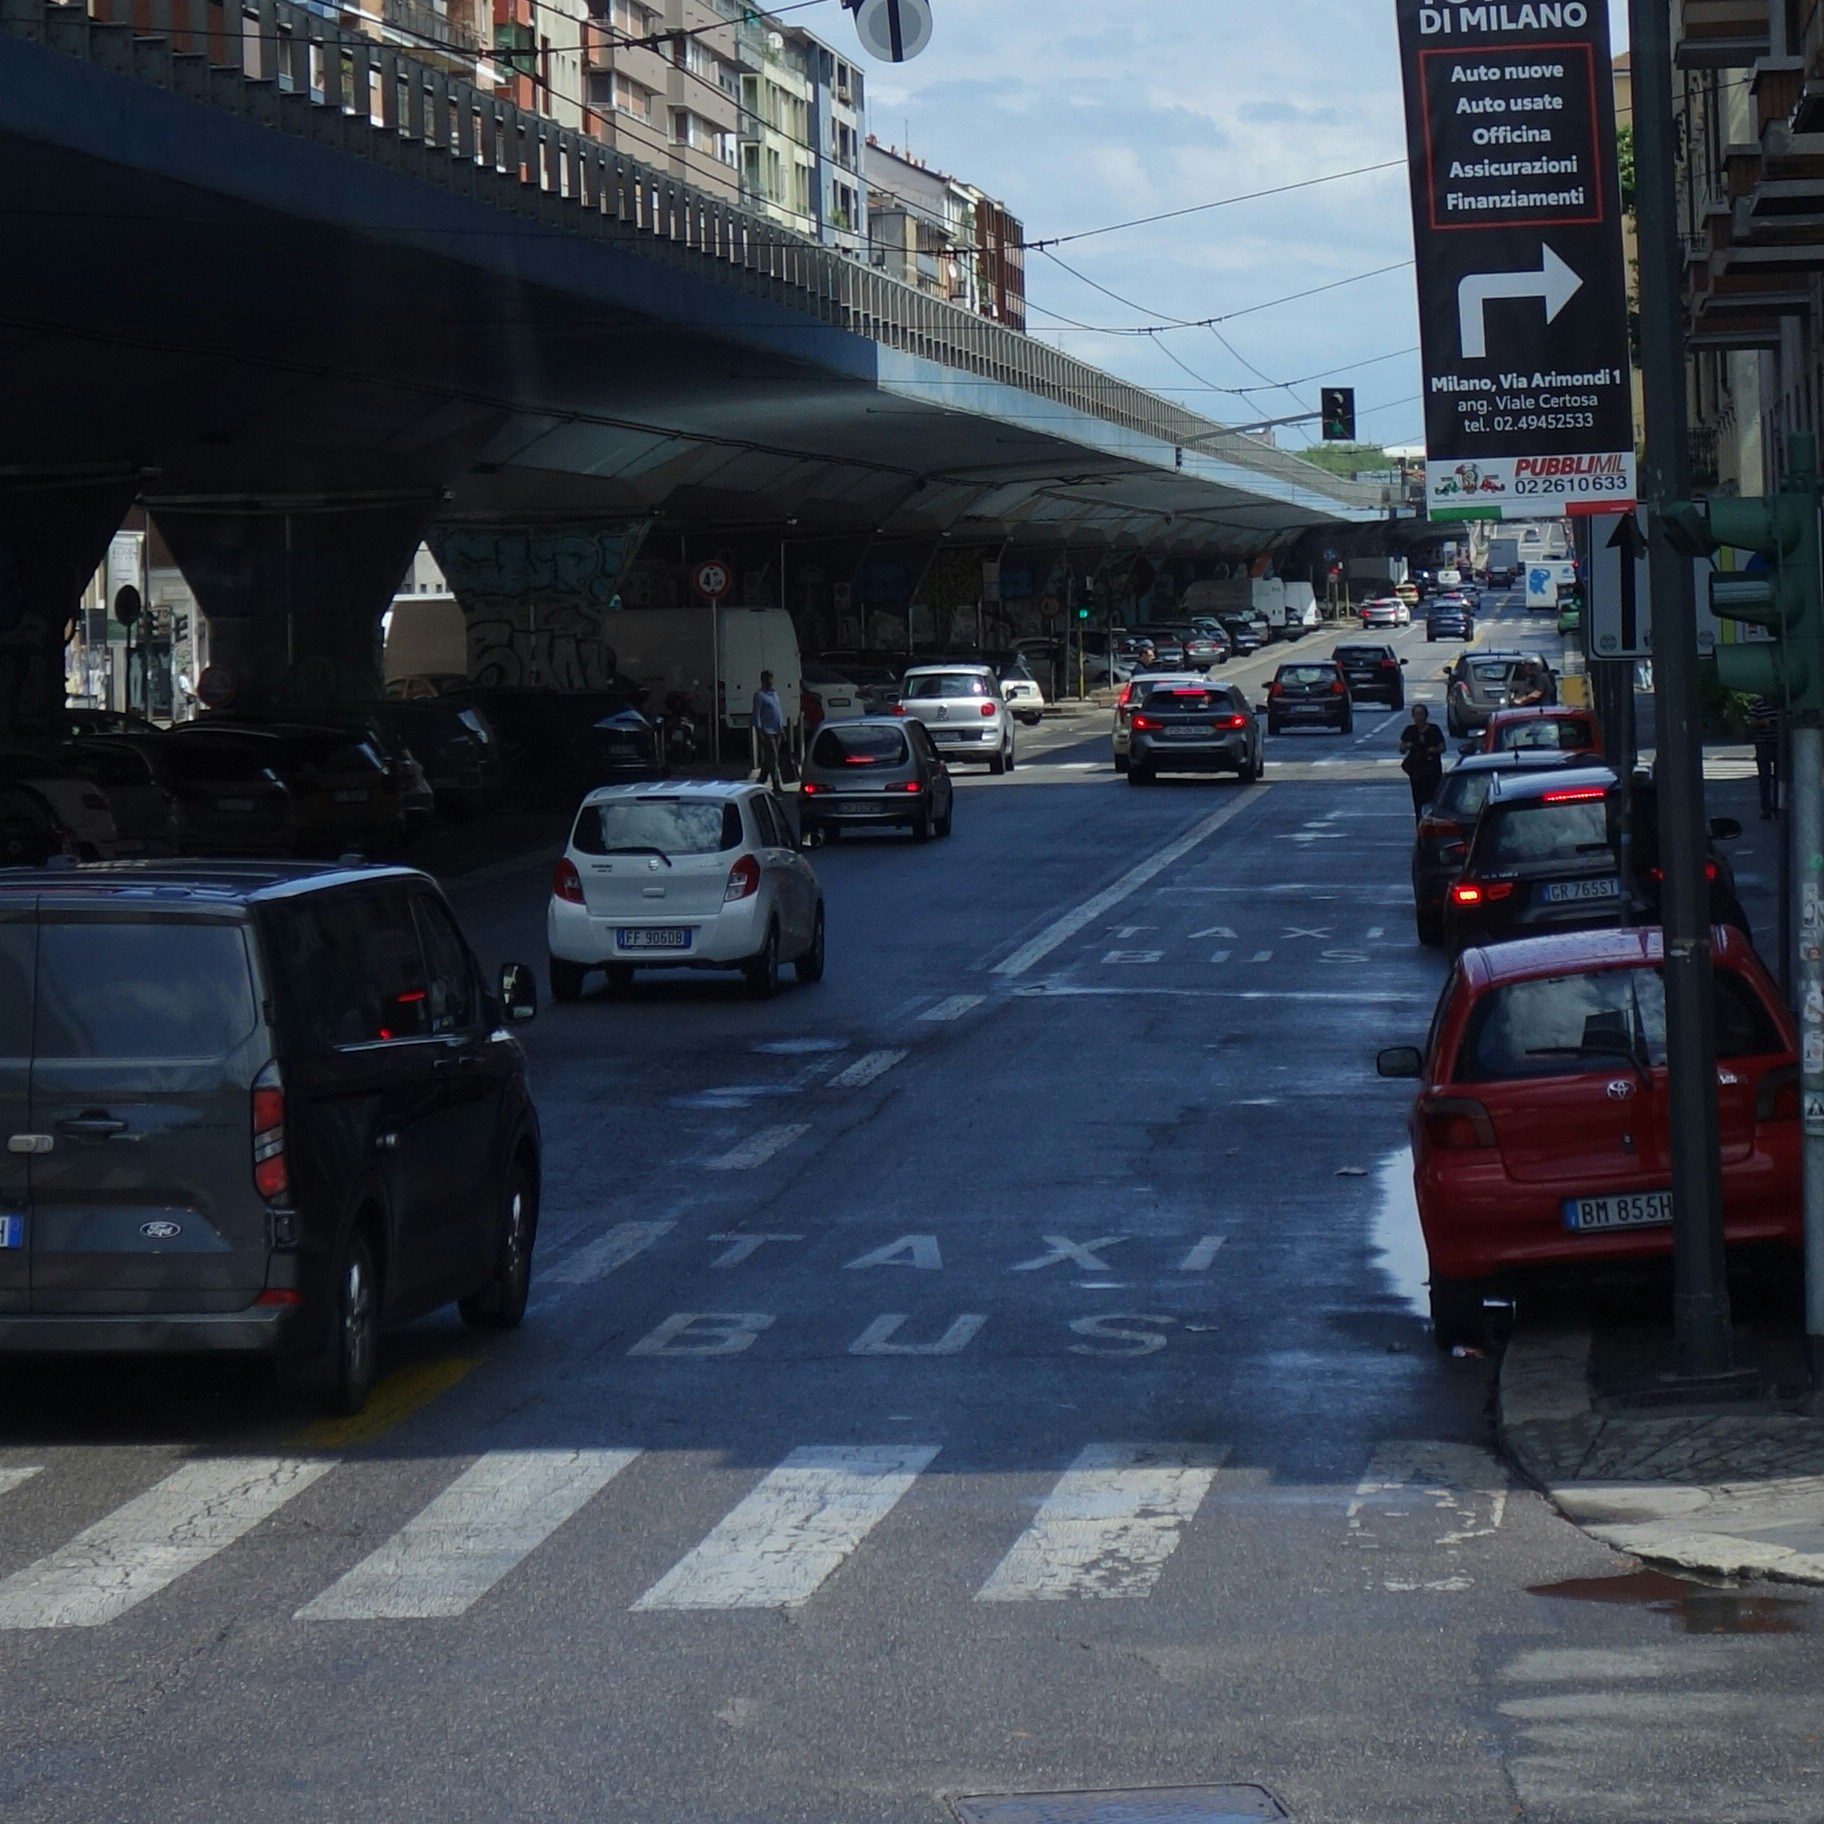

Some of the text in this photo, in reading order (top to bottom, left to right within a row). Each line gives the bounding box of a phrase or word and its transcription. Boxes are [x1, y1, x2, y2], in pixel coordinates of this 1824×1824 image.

[1419, 2, 1587, 34] DI MILANO
[1451, 64, 1564, 83] Auto nuove
[1456, 94, 1563, 114] Auto usate
[1472, 125, 1551, 145] Officina
[1449, 155, 1578, 178] Assicurazioni
[1446, 187, 1584, 210] Finanziamenti
[1431, 368, 1621, 393] Milano, Via Arimondi 1
[1458, 393, 1598, 414] ang. Viale Certosa
[1464, 413, 1594, 432] tel. 02.49452533
[1515, 454, 1626, 477] PUBBLIMIL
[1551, 886, 1569, 900] GR
[1106, 925, 1385, 939] TAXI
[1581, 1199, 1609, 1225] BM
[707, 1233, 1227, 1271] TAXI
[627, 1311, 1176, 1357] BUS
